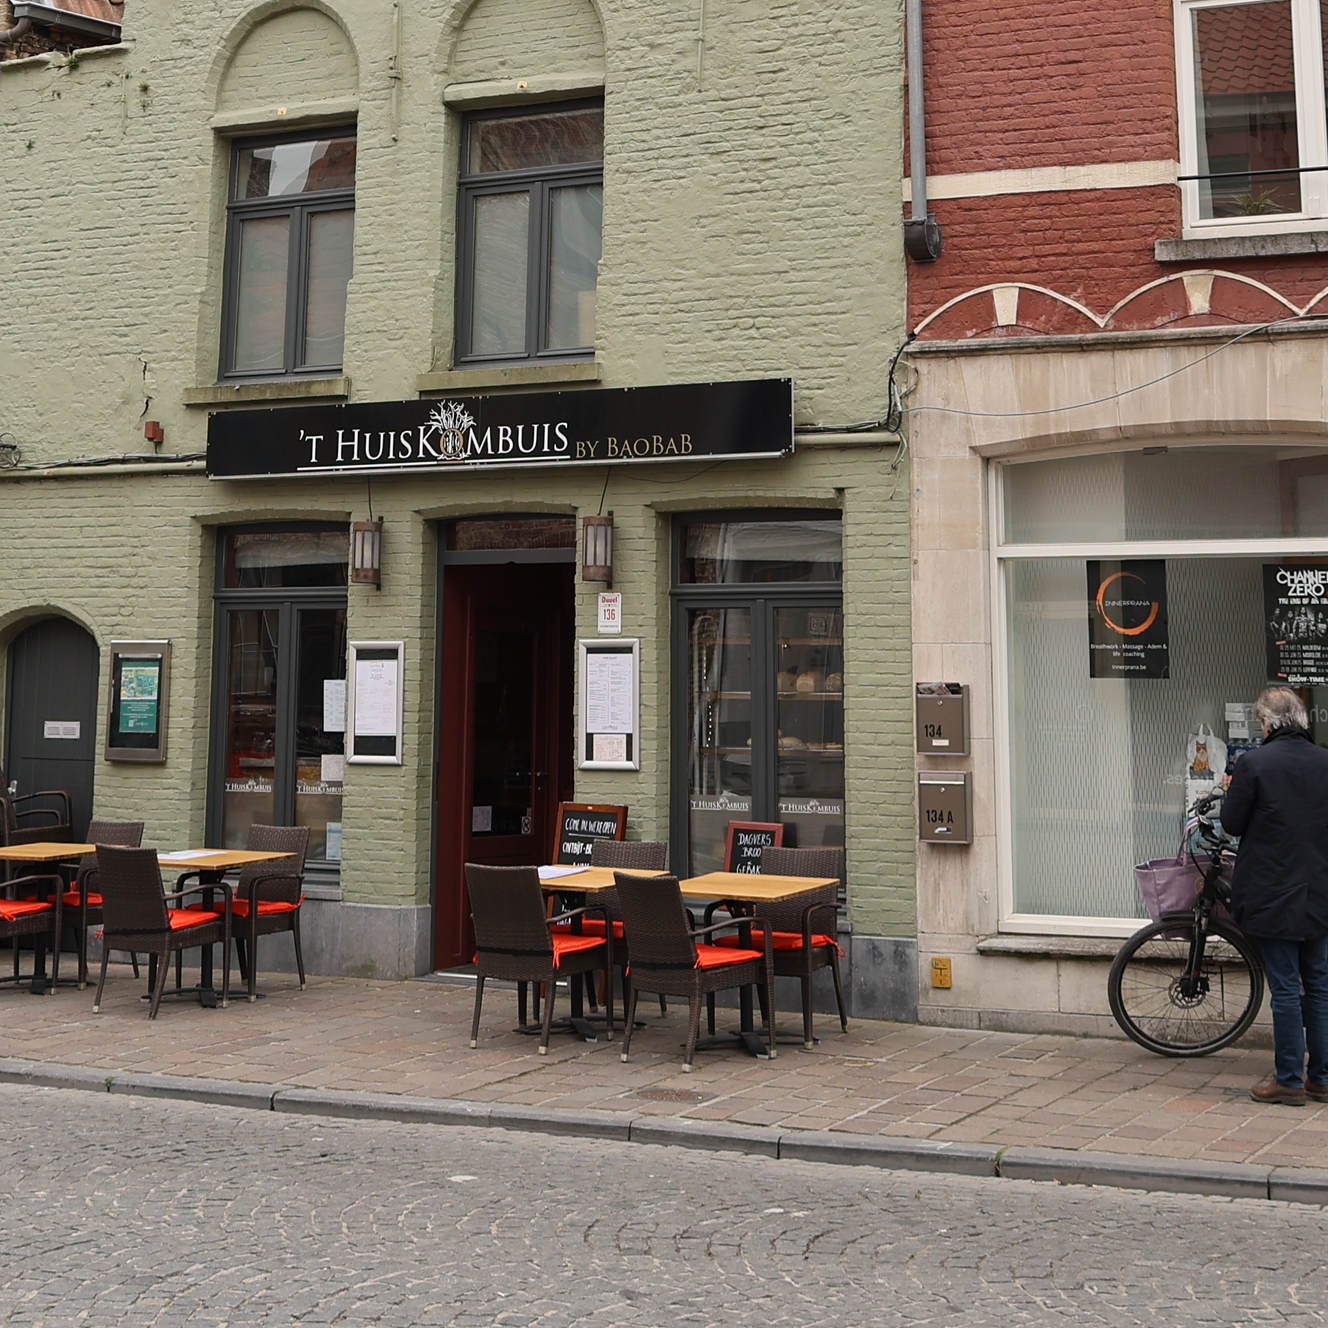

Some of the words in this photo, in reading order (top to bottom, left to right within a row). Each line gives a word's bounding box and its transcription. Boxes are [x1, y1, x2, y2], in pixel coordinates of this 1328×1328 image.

[575, 440, 600, 459] BY
[1288, 583, 1325, 599] ZERO
[603, 609, 616, 621] 136
[924, 724, 942, 738] 134
[926, 810, 945, 823] 134
[947, 810, 954, 823] A
[741, 847, 762, 858] BROO
